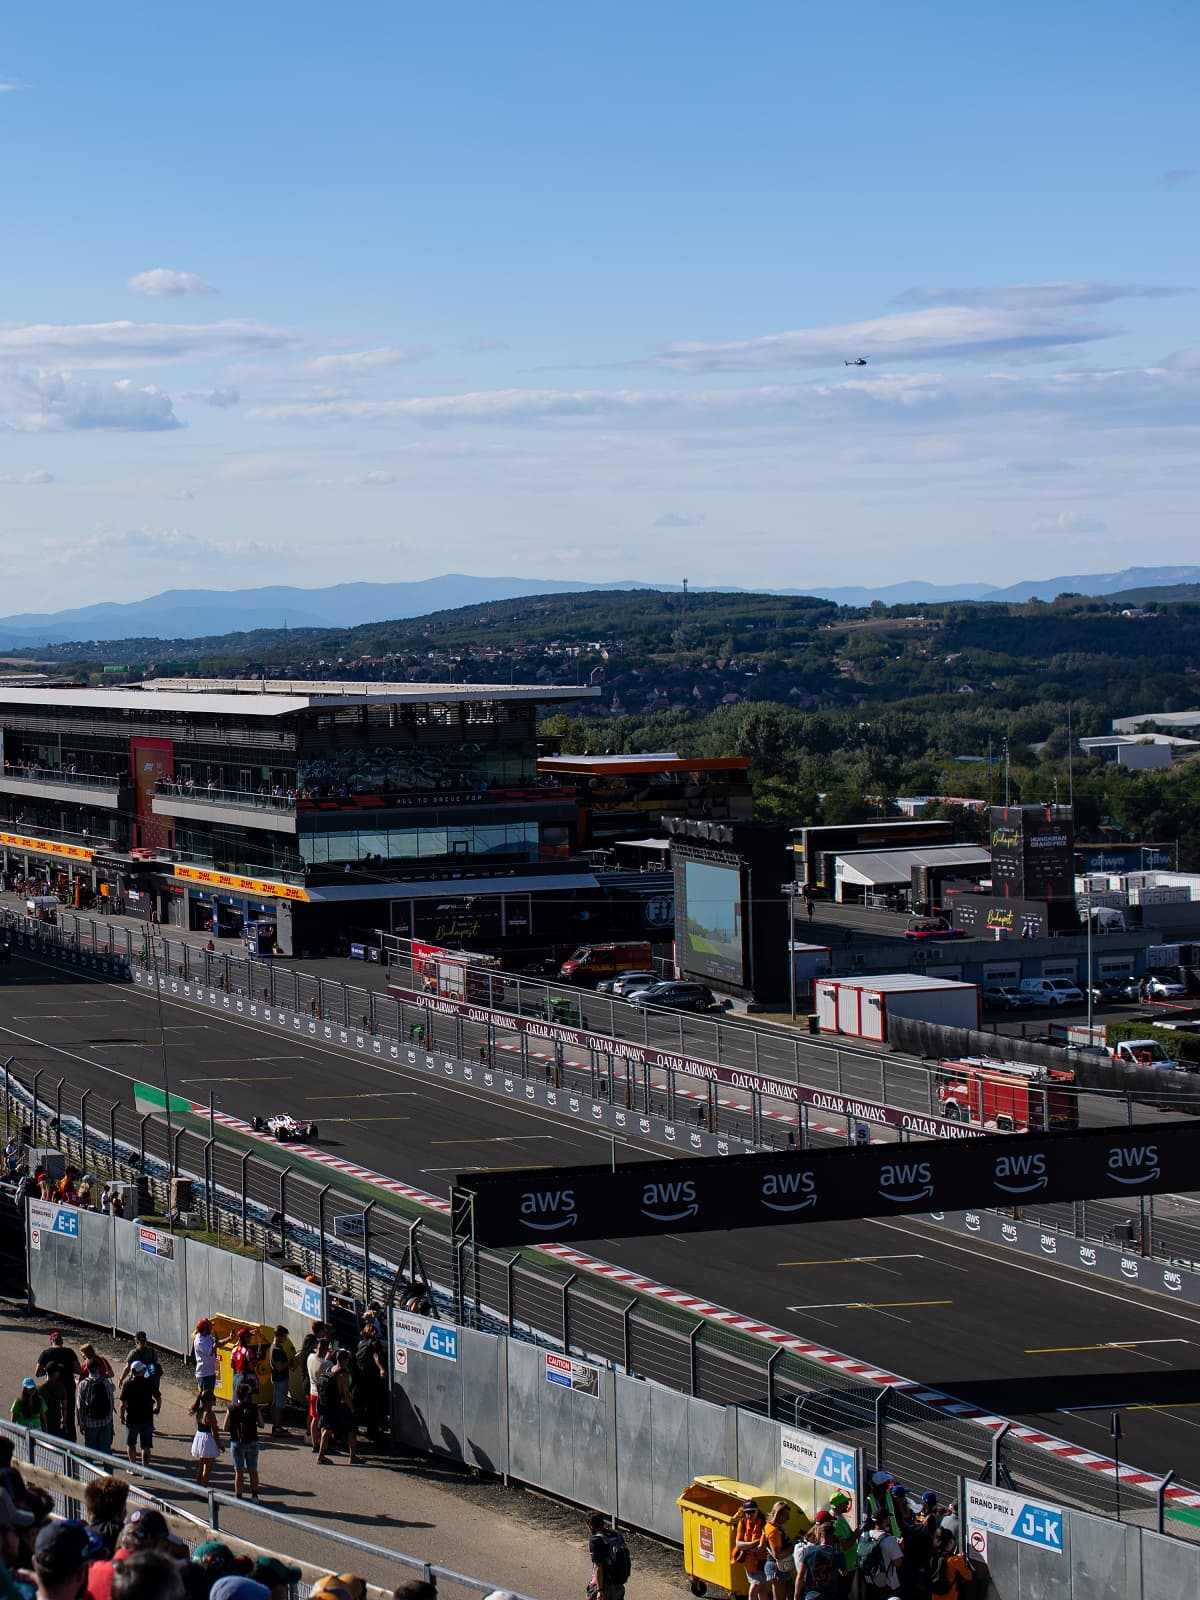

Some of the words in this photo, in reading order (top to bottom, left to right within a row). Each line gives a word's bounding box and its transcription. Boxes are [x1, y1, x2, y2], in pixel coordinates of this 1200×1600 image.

[468, 1008, 489, 1022] QATAR
[490, 1013, 517, 1029] AIRWAYS
[526, 1022, 548, 1038] QATAR
[589, 1037, 613, 1053] QATAR
[615, 1043, 645, 1061] AIRWAYS
[657, 1054, 683, 1071] QATAR
[685, 1060, 718, 1080] AIRWAYS
[731, 1072, 759, 1090] QATAR
[761, 1081, 798, 1099] AIRWAYS
[813, 1093, 844, 1112] QATAR
[846, 1102, 886, 1122] AIRWAYS
[902, 1115, 937, 1136] QATAR
[995, 1153, 1046, 1177] aws
[1108, 1145, 1159, 1168] aws
[762, 1171, 815, 1195] aws
[880, 1162, 932, 1186] aws
[520, 1189, 575, 1214] aws
[642, 1180, 696, 1205] aws
[58, 1215, 76, 1233] E-F
[965, 1212, 980, 1225] aws
[1001, 1223, 1017, 1236] aws
[1040, 1234, 1056, 1247] aws
[1080, 1246, 1096, 1259] aws
[1121, 1257, 1138, 1271] aws
[1163, 1270, 1181, 1284] aws
[304, 1294, 321, 1316] G-H
[430, 1331, 455, 1355] G-H
[548, 1356, 570, 1370] CAUTION
[783, 1440, 800, 1453] GRAND
[801, 1447, 812, 1457] PRIX
[823, 1456, 853, 1485] J-K
[970, 1496, 993, 1510] GRAND
[993, 1503, 1009, 1514] PRIX
[1022, 1513, 1060, 1544] J-K
